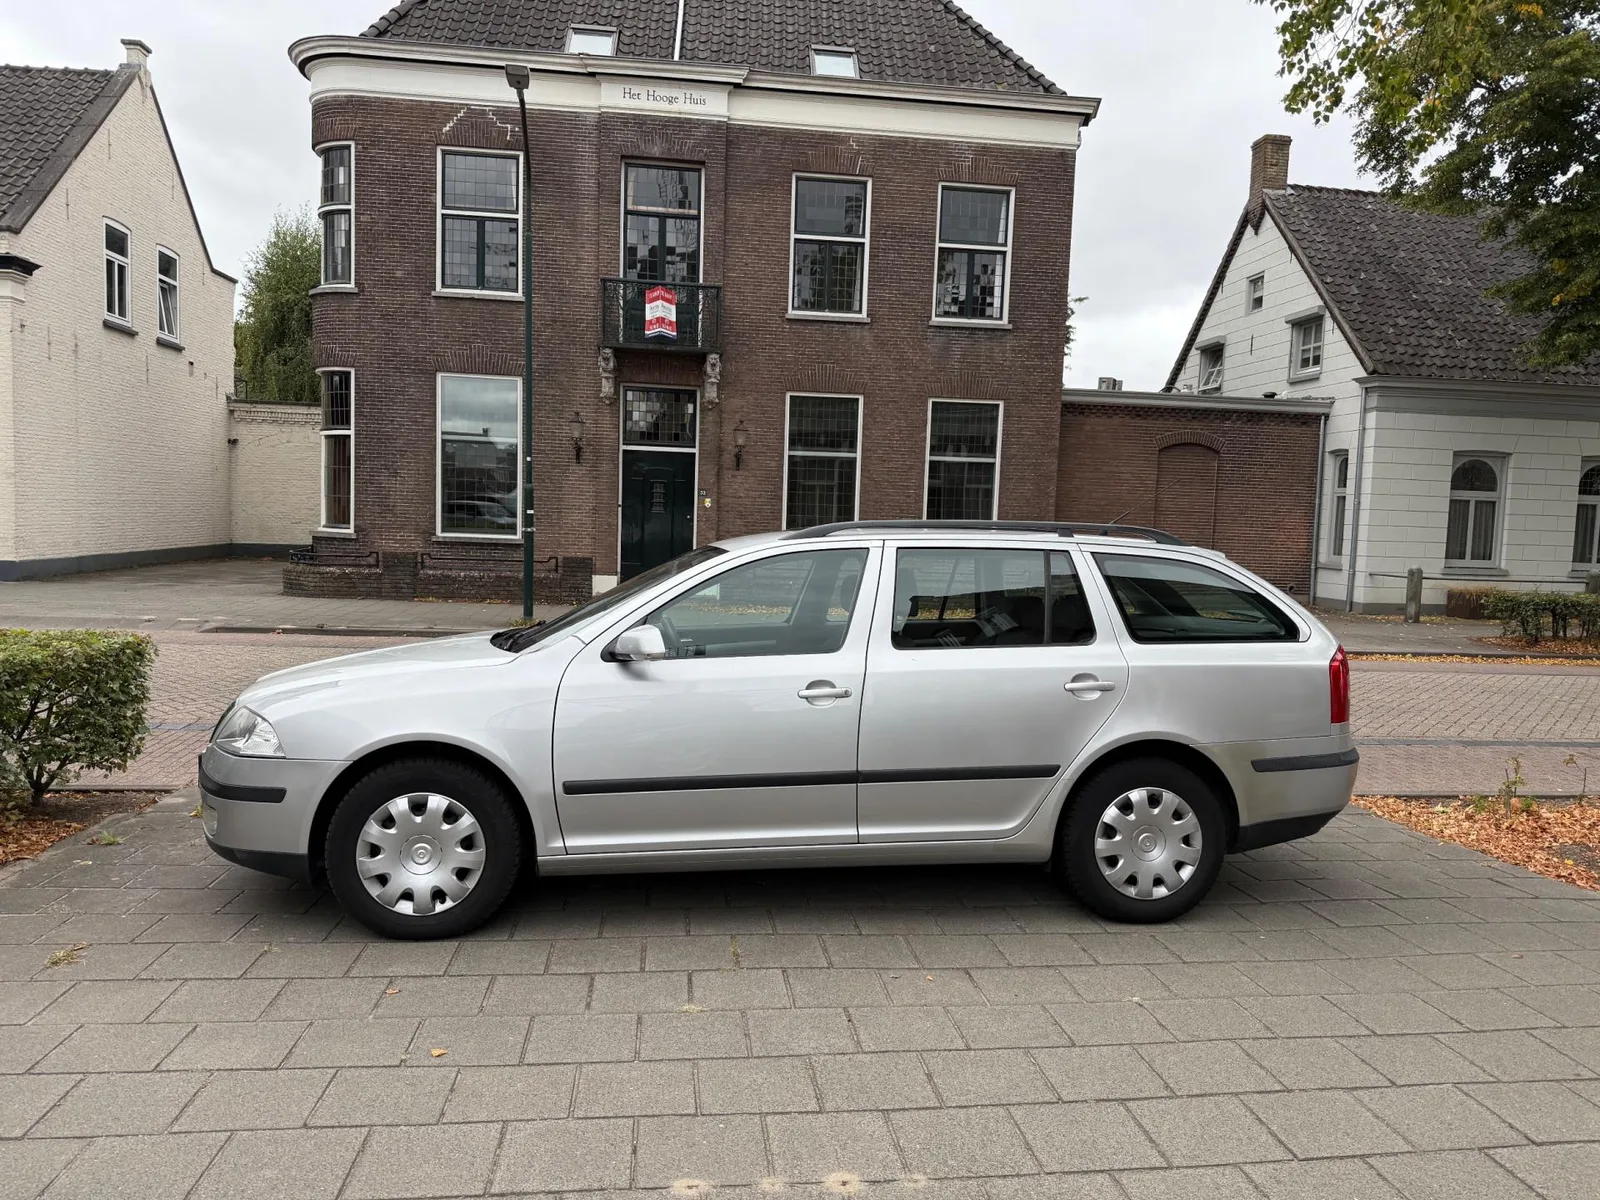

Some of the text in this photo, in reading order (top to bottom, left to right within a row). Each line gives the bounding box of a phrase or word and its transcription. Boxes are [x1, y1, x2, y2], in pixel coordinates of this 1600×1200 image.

[623, 87, 706, 105] Het Hooge Huis
